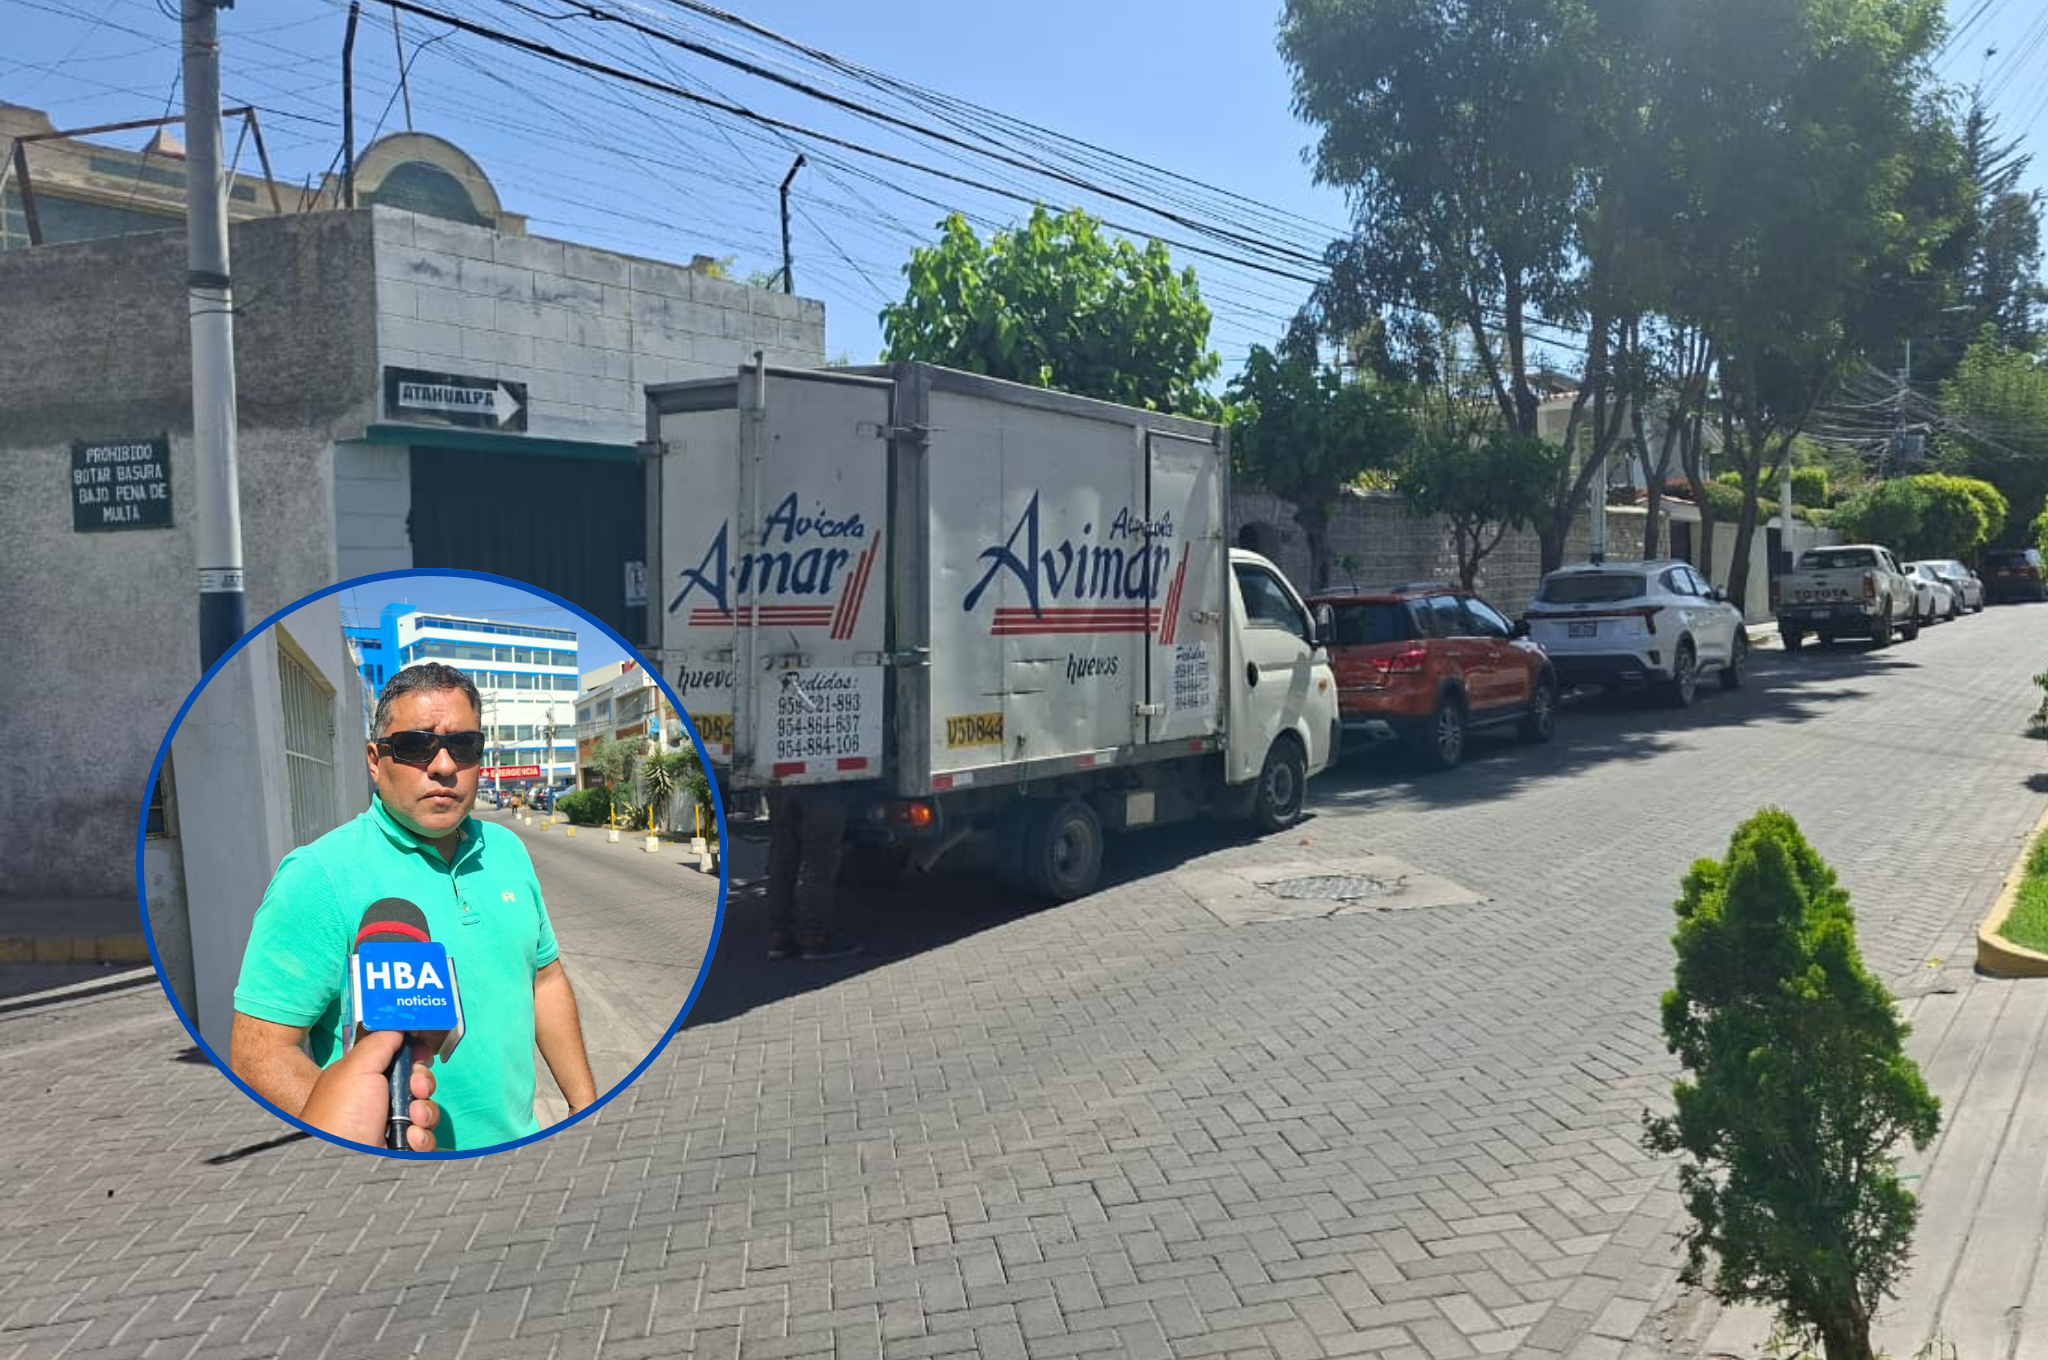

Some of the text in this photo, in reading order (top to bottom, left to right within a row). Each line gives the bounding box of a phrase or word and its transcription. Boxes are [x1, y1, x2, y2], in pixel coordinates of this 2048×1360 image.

[403, 385, 495, 406] ATAHUALPA
[86, 444, 153, 463] PROHIBIDO
[73, 463, 163, 485] BOTAR BASURA
[79, 482, 168, 504] BAJO PENA DE
[103, 505, 140, 522] MULTA
[963, 488, 1170, 619] Avimar
[1795, 588, 1849, 599] TOYOTA
[1066, 653, 1119, 684] huevos
[778, 714, 860, 738] 954-864-637
[366, 962, 444, 990] HBA
[397, 995, 447, 1006] noticias
